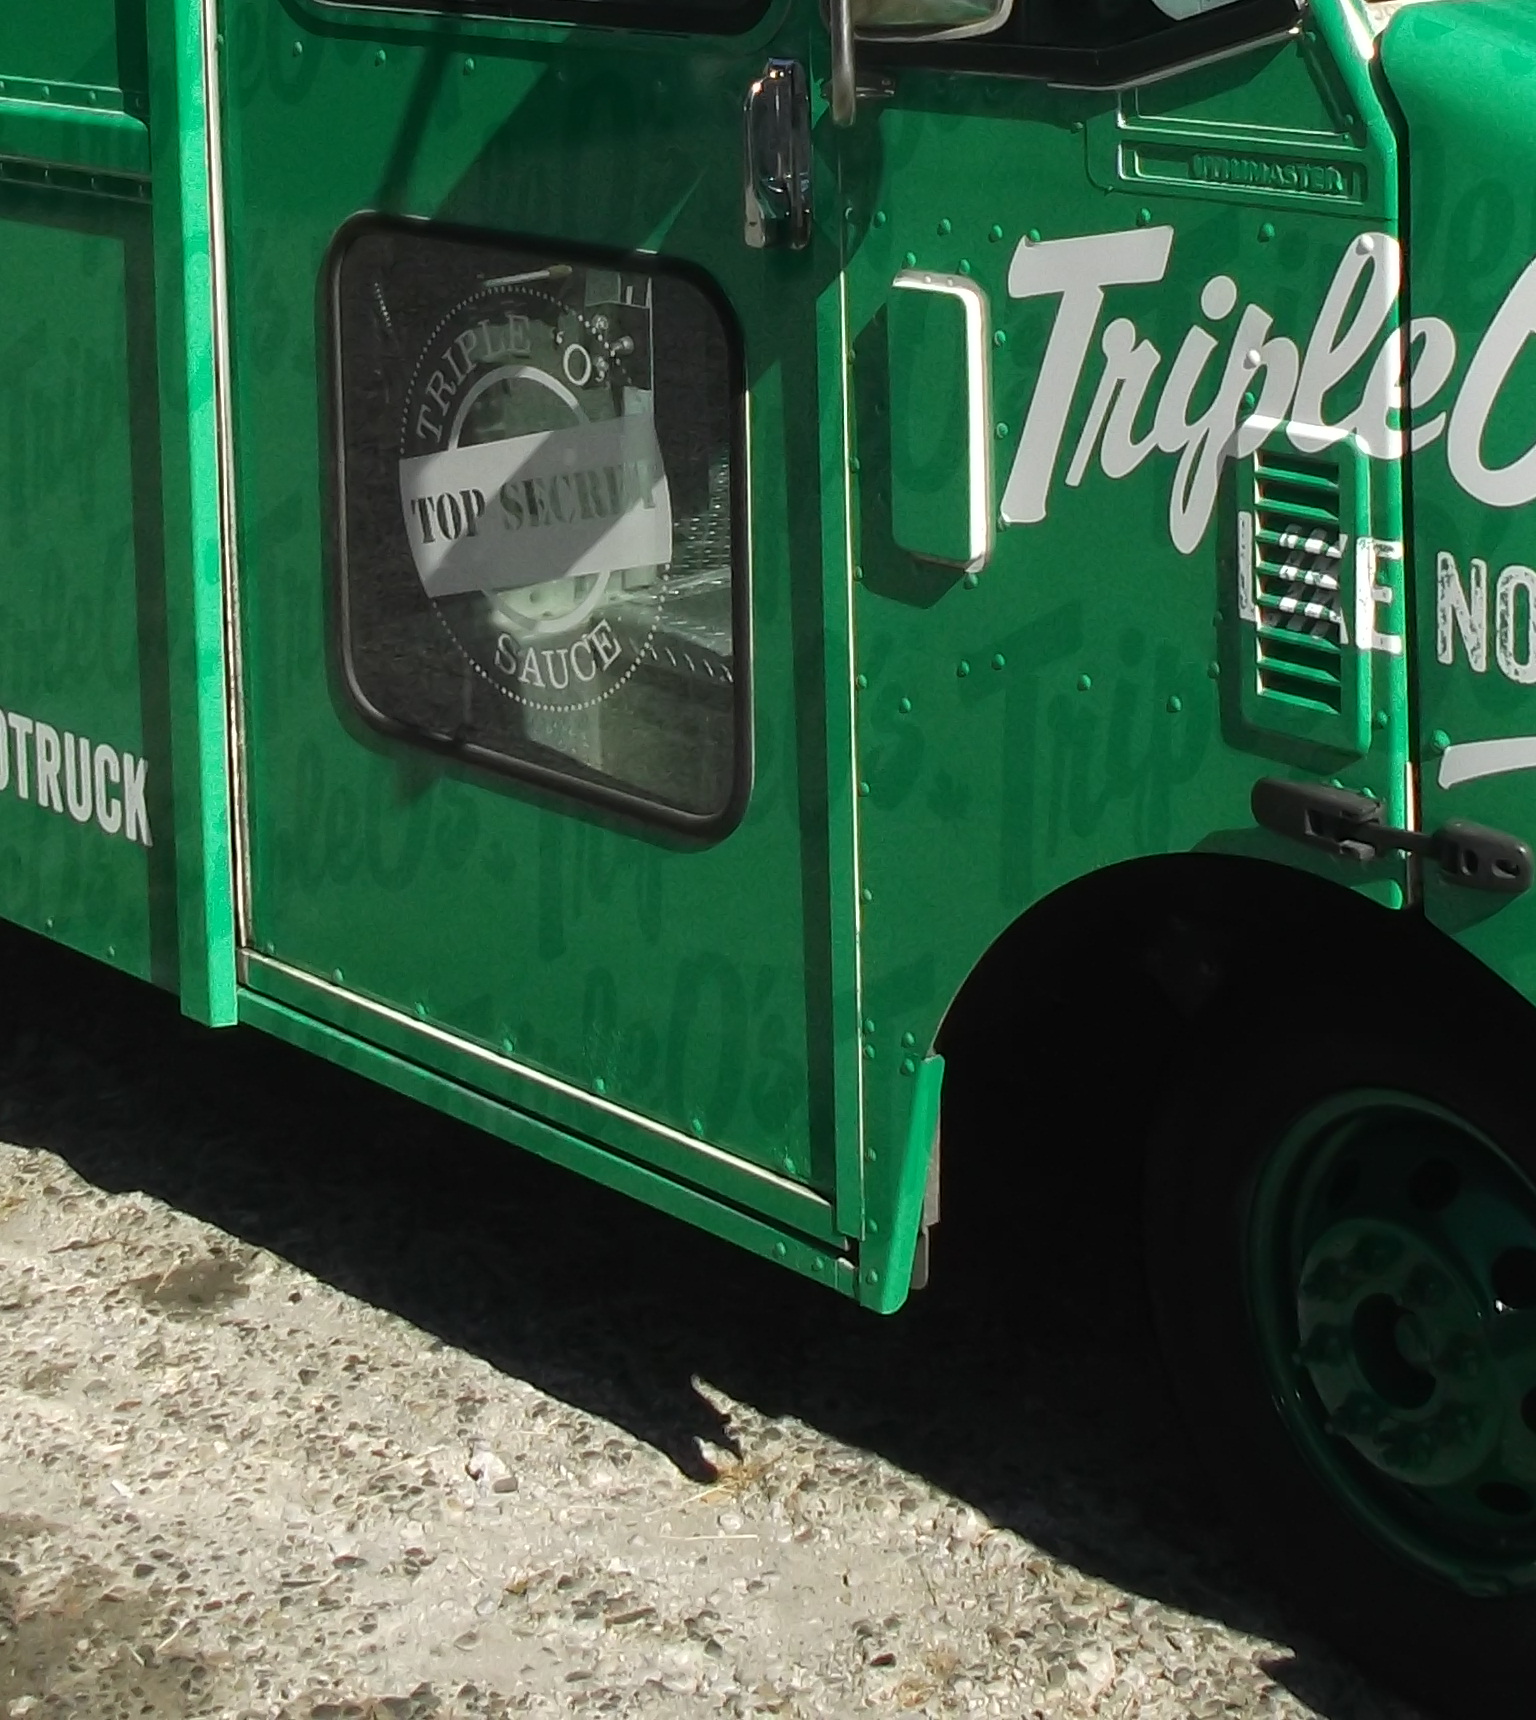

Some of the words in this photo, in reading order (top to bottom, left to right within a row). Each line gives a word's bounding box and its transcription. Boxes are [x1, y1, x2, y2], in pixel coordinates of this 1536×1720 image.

[416, 312, 531, 443] TRIPLE
[411, 488, 487, 544] TOP
[493, 620, 624, 690] SAUCE
